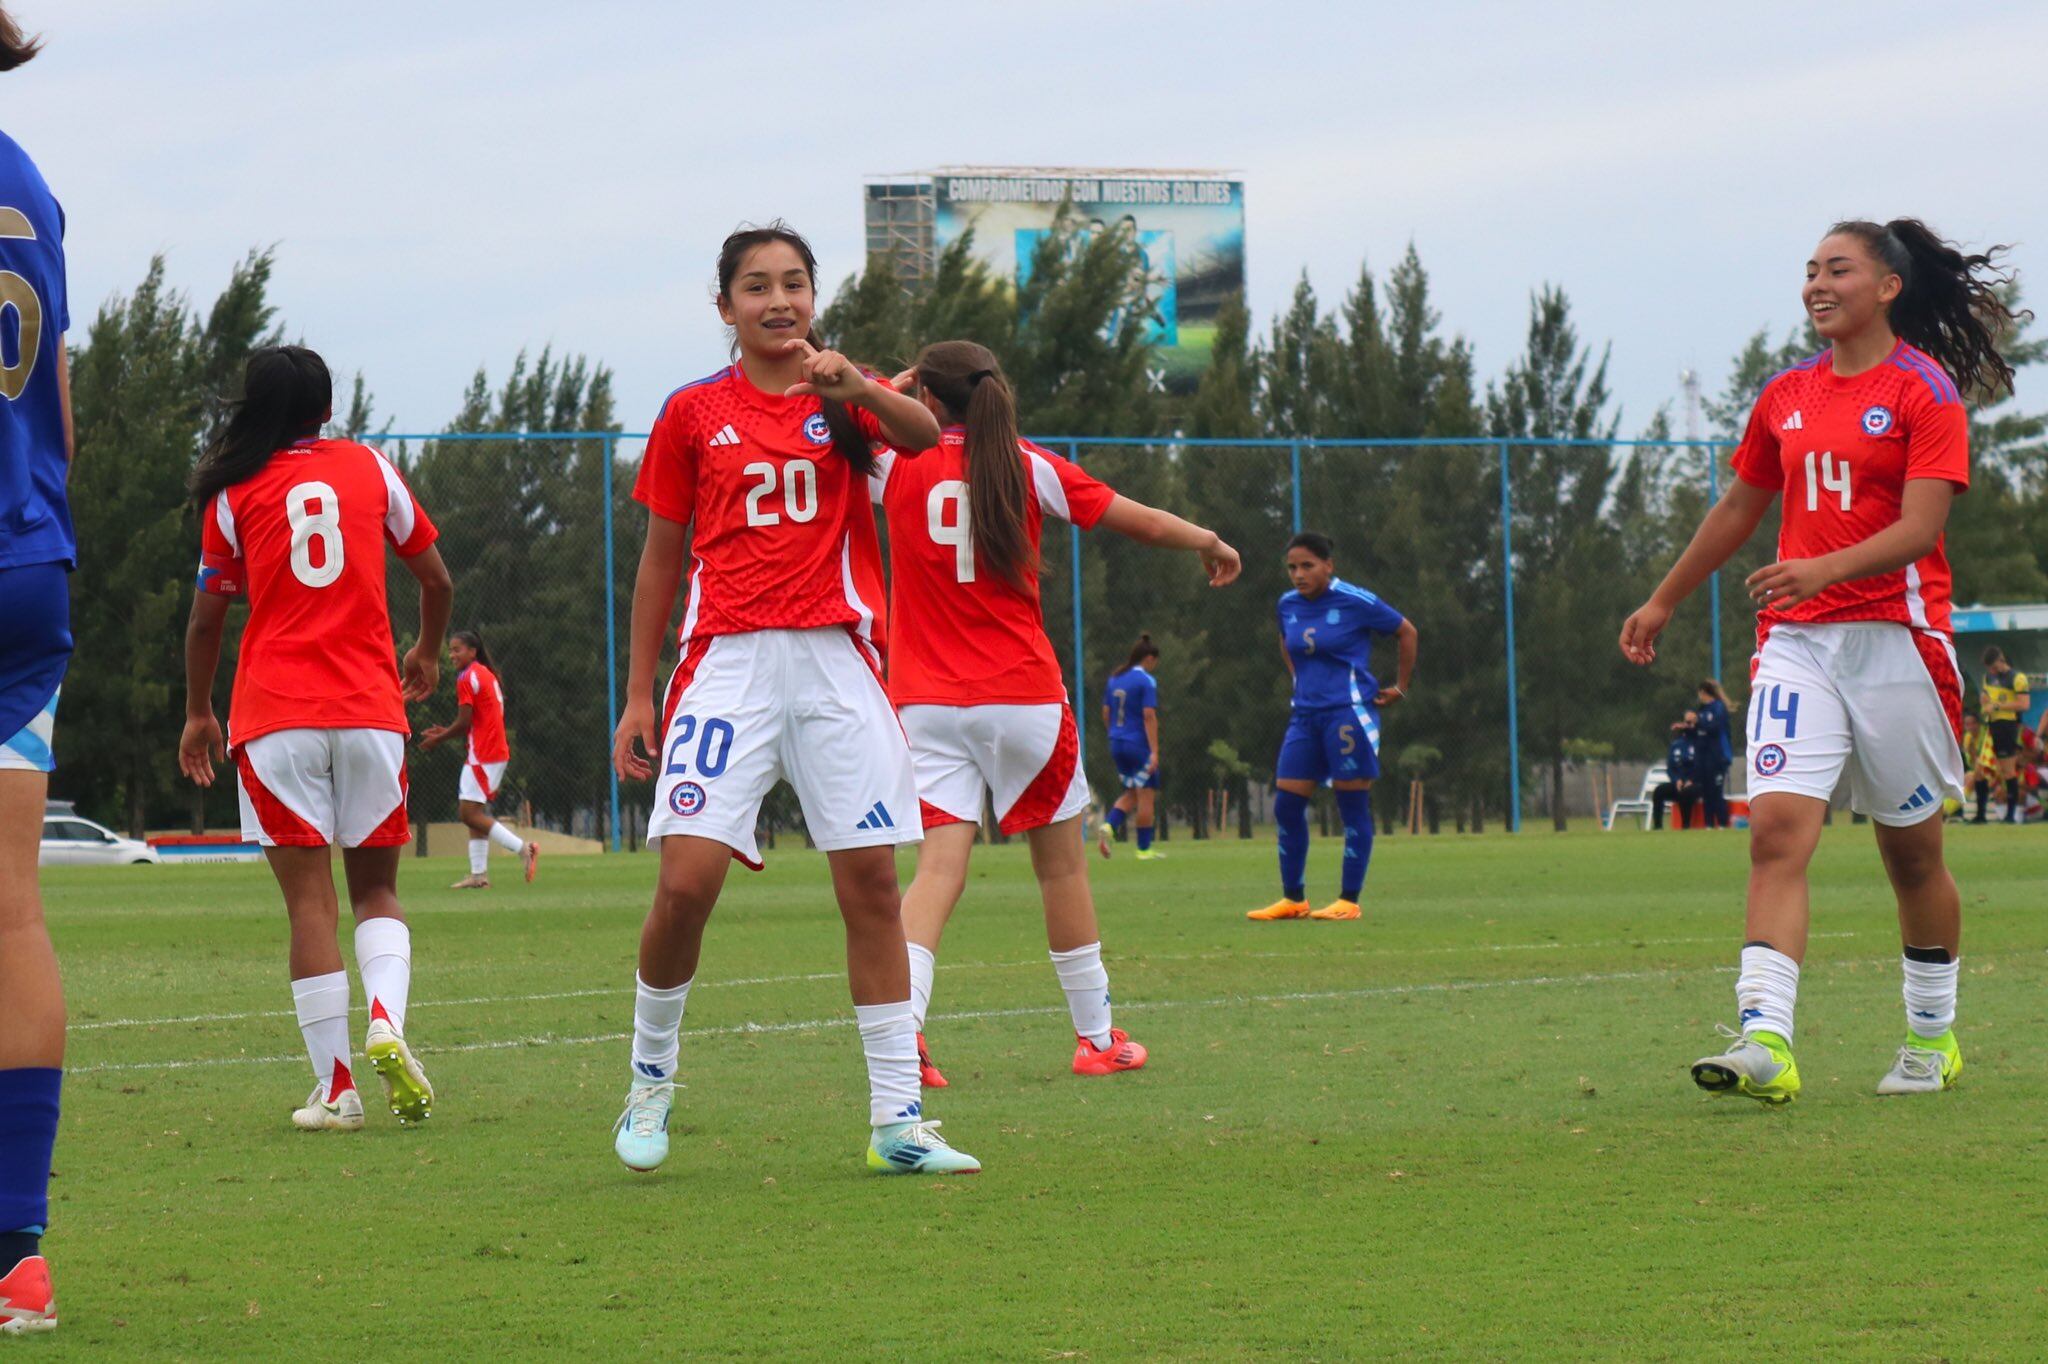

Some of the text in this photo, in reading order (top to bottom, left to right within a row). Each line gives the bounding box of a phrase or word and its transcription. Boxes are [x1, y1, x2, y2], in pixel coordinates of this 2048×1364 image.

[1071, 180, 1099, 202] CON
[1102, 180, 1169, 203] NUESTROS
[1173, 182, 1231, 204] COLORES
[743, 459, 818, 527] 20
[1805, 451, 1851, 511] 14
[286, 481, 345, 588] 8
[927, 480, 976, 583] 9
[1303, 627, 1317, 655] 5
[1112, 688, 1127, 727] 7
[1754, 683, 1800, 742] 14
[665, 714, 735, 778] 20
[1338, 725, 1356, 754] 5
